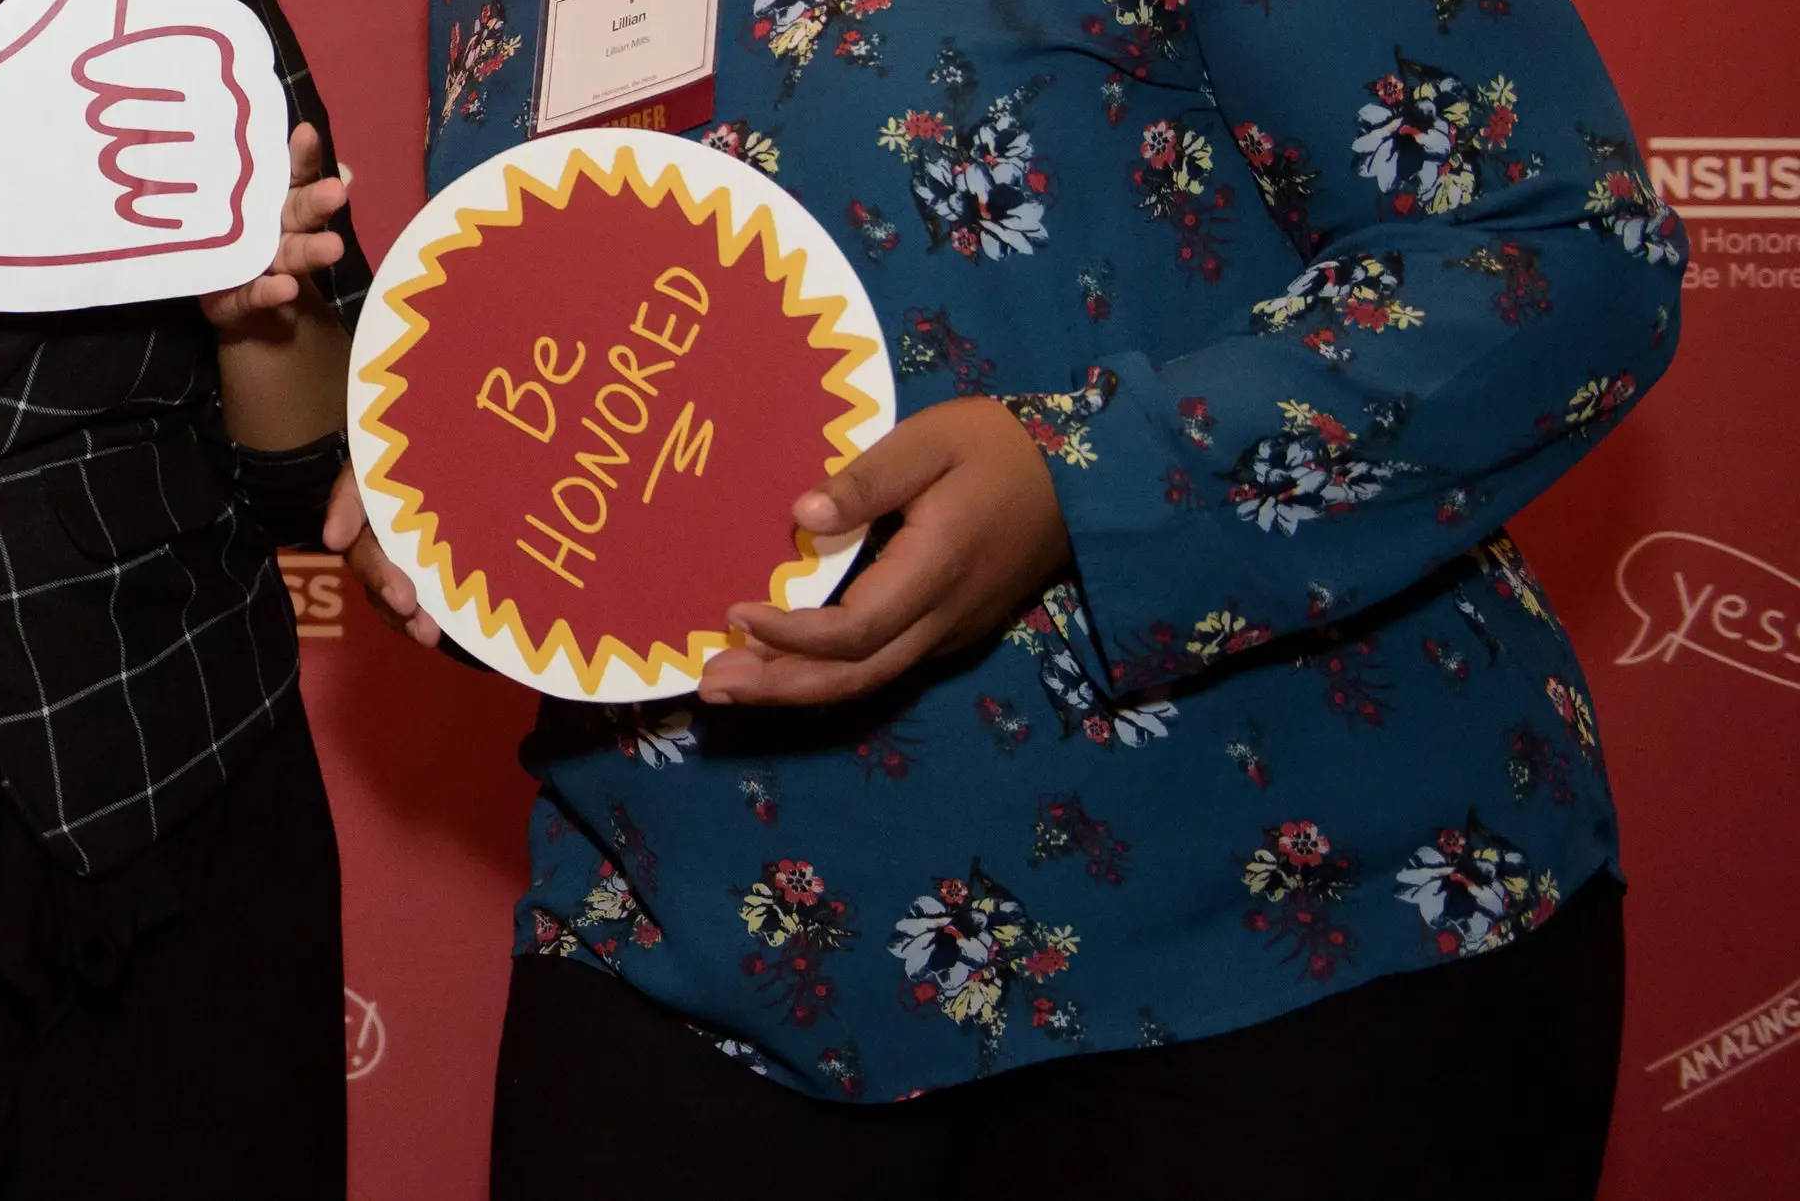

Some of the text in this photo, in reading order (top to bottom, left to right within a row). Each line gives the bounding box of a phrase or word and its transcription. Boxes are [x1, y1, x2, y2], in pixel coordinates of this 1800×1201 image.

[611, 11, 647, 32] Lillian
[1650, 156, 1800, 200] NSHS
[1702, 229, 1800, 254] Honor
[1730, 263, 1800, 289] More
[476, 336, 587, 443] Be
[516, 266, 709, 589] HONORED
[1662, 572, 1800, 667] yes
[1680, 997, 1800, 1090] AMAZING
